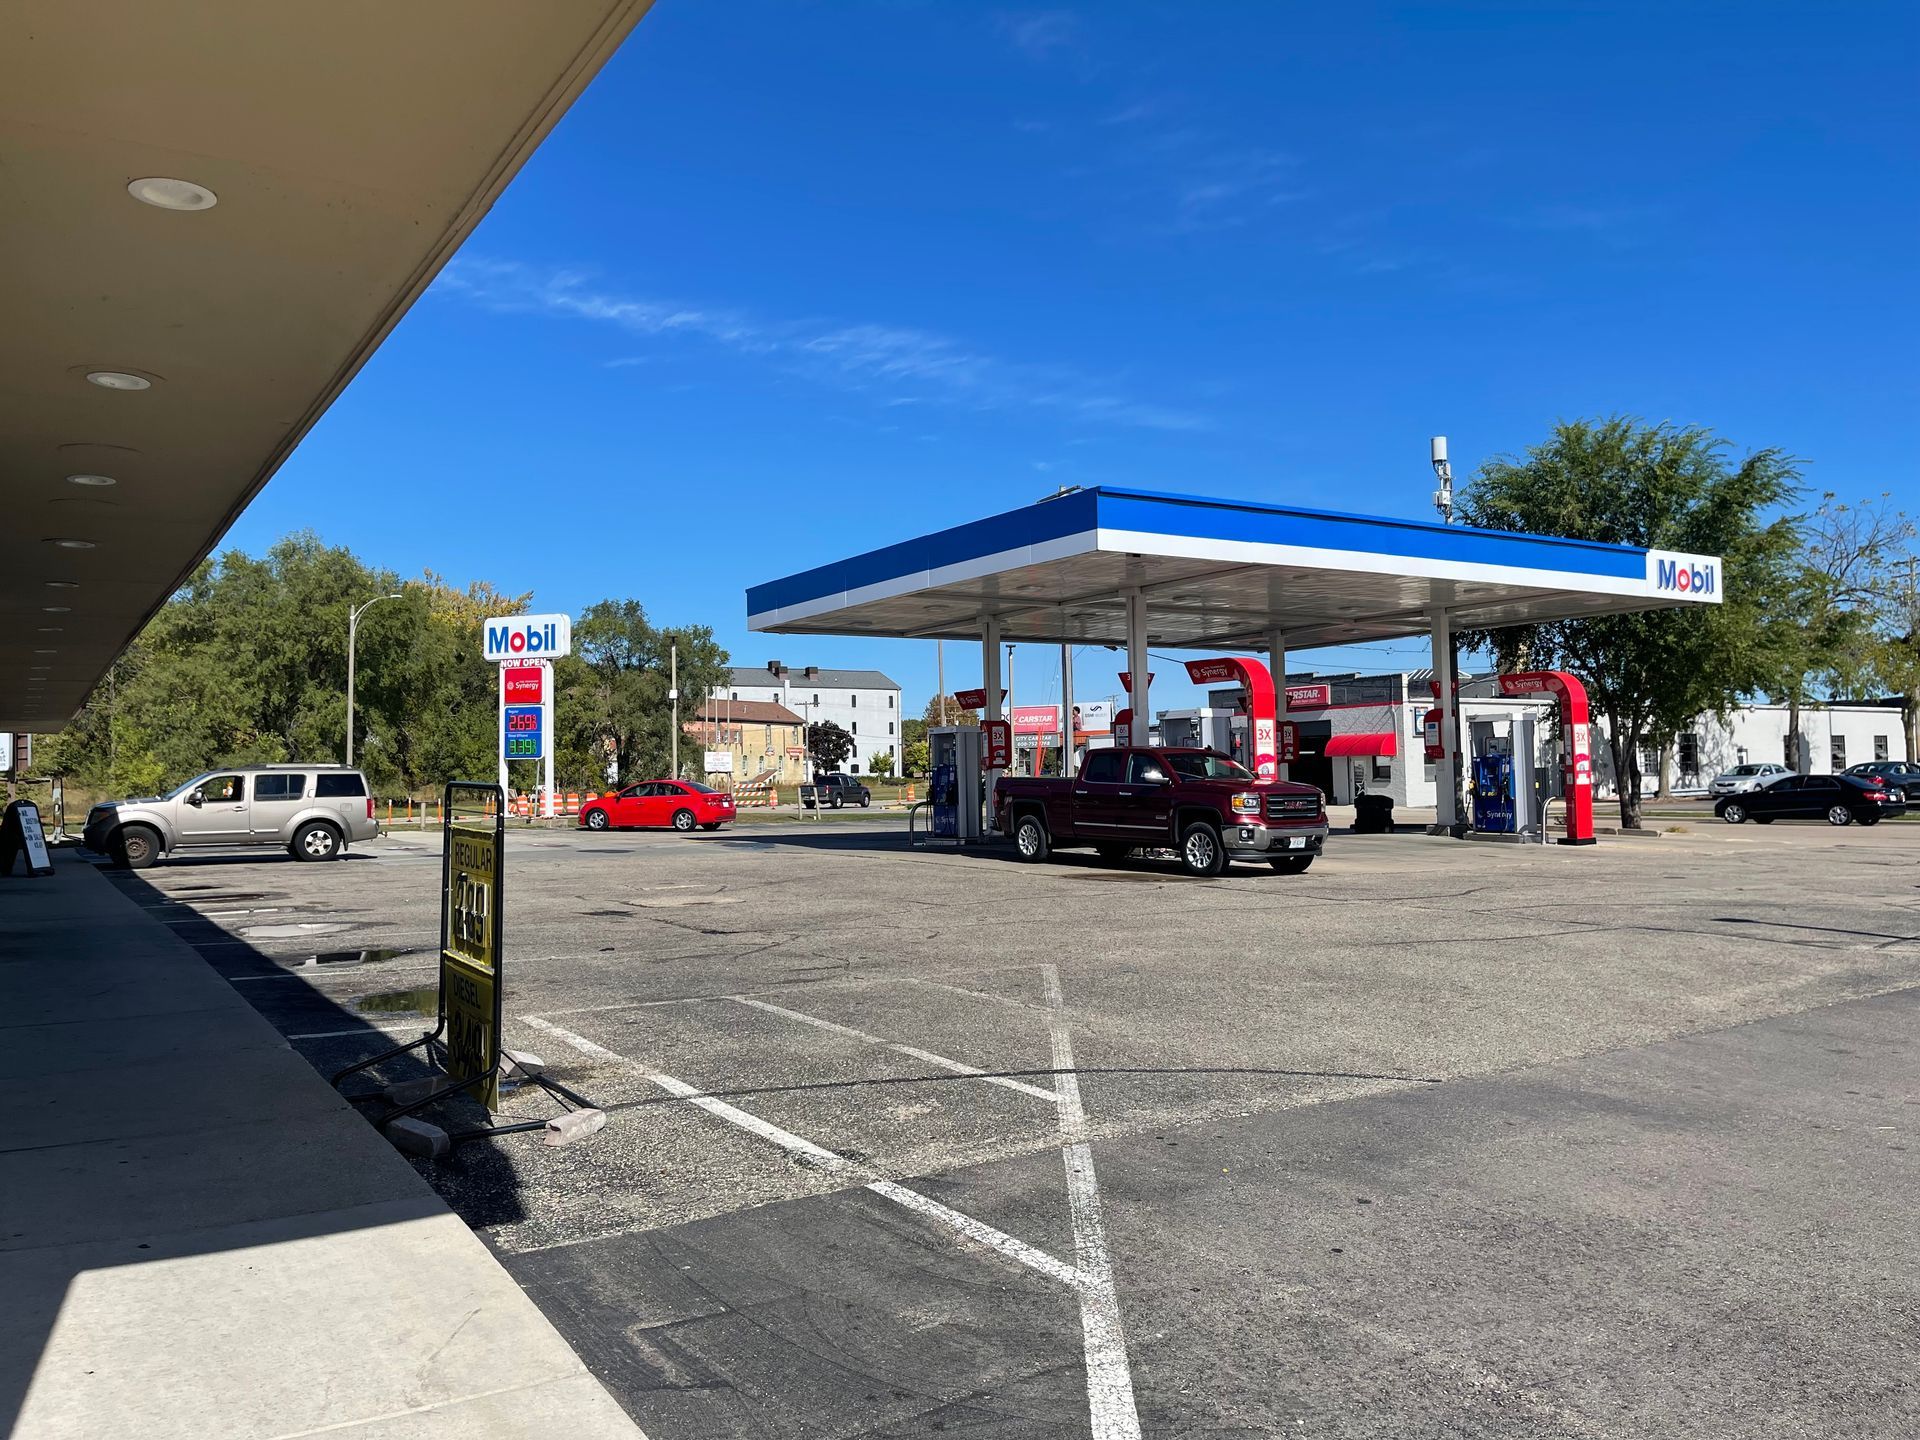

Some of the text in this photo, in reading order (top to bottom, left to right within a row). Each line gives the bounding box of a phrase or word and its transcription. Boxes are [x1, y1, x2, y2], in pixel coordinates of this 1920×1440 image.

[1656, 559, 1714, 594] Mobil
[488, 623, 556, 654] Mobil
[501, 658, 546, 668] NOW OPEN
[1200, 667, 1228, 678] Synergy
[515, 681, 539, 690] Synergy
[1515, 680, 1543, 688] Synergy
[1019, 714, 1053, 724] CARSTAR
[993, 731, 1004, 740] 3X
[1258, 729, 1272, 740] 3X
[455, 843, 492, 873] REGULAR
[453, 973, 481, 1010] DIESEL
